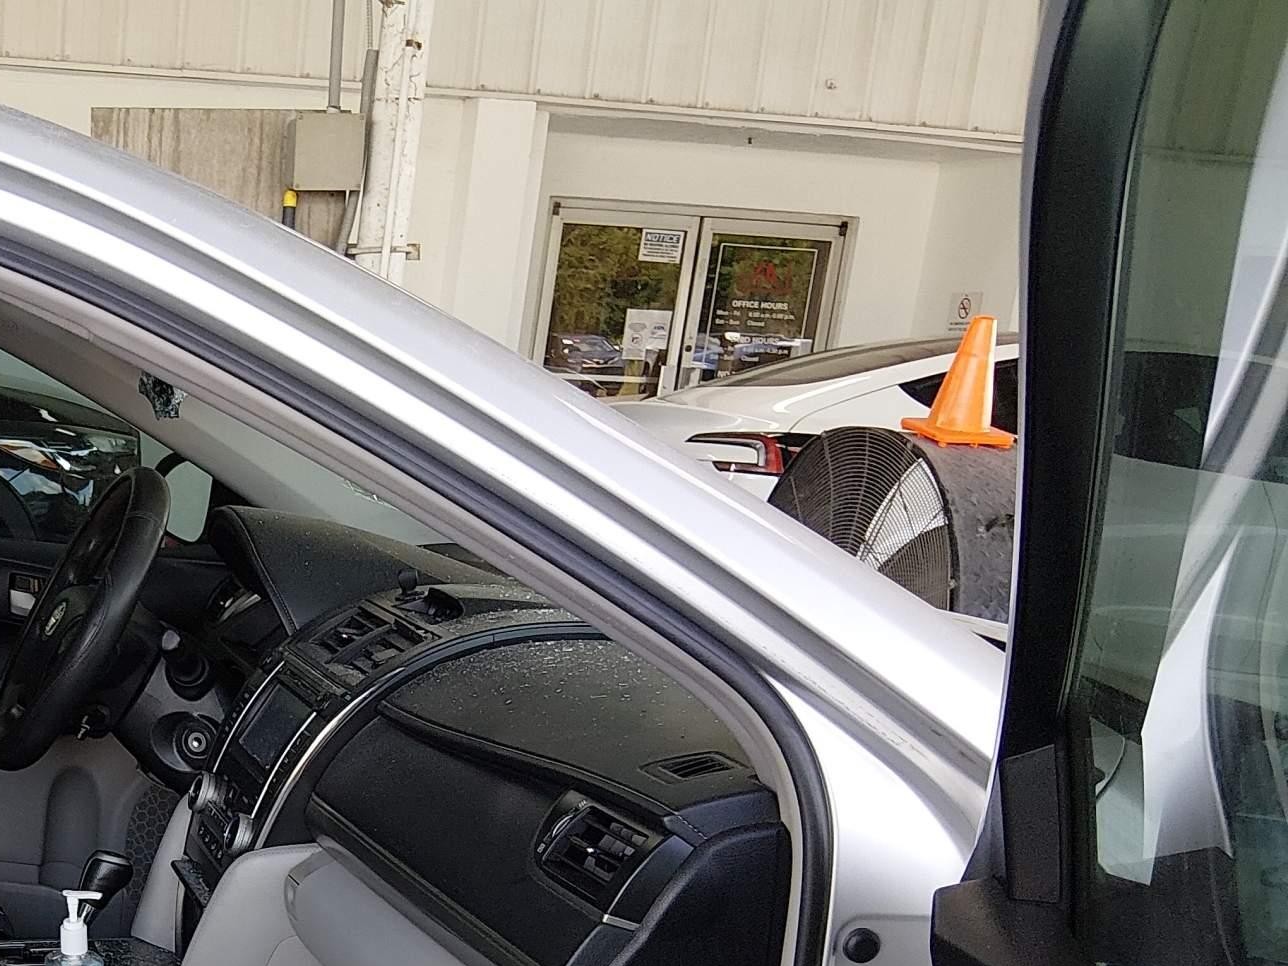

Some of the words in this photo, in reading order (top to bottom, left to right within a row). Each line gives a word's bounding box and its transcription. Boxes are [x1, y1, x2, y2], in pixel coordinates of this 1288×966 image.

[646, 233, 680, 242] NOTICE
[732, 300, 759, 309] OFFICE
[760, 302, 789, 310] HOURS
[752, 337, 780, 345] HOURS
